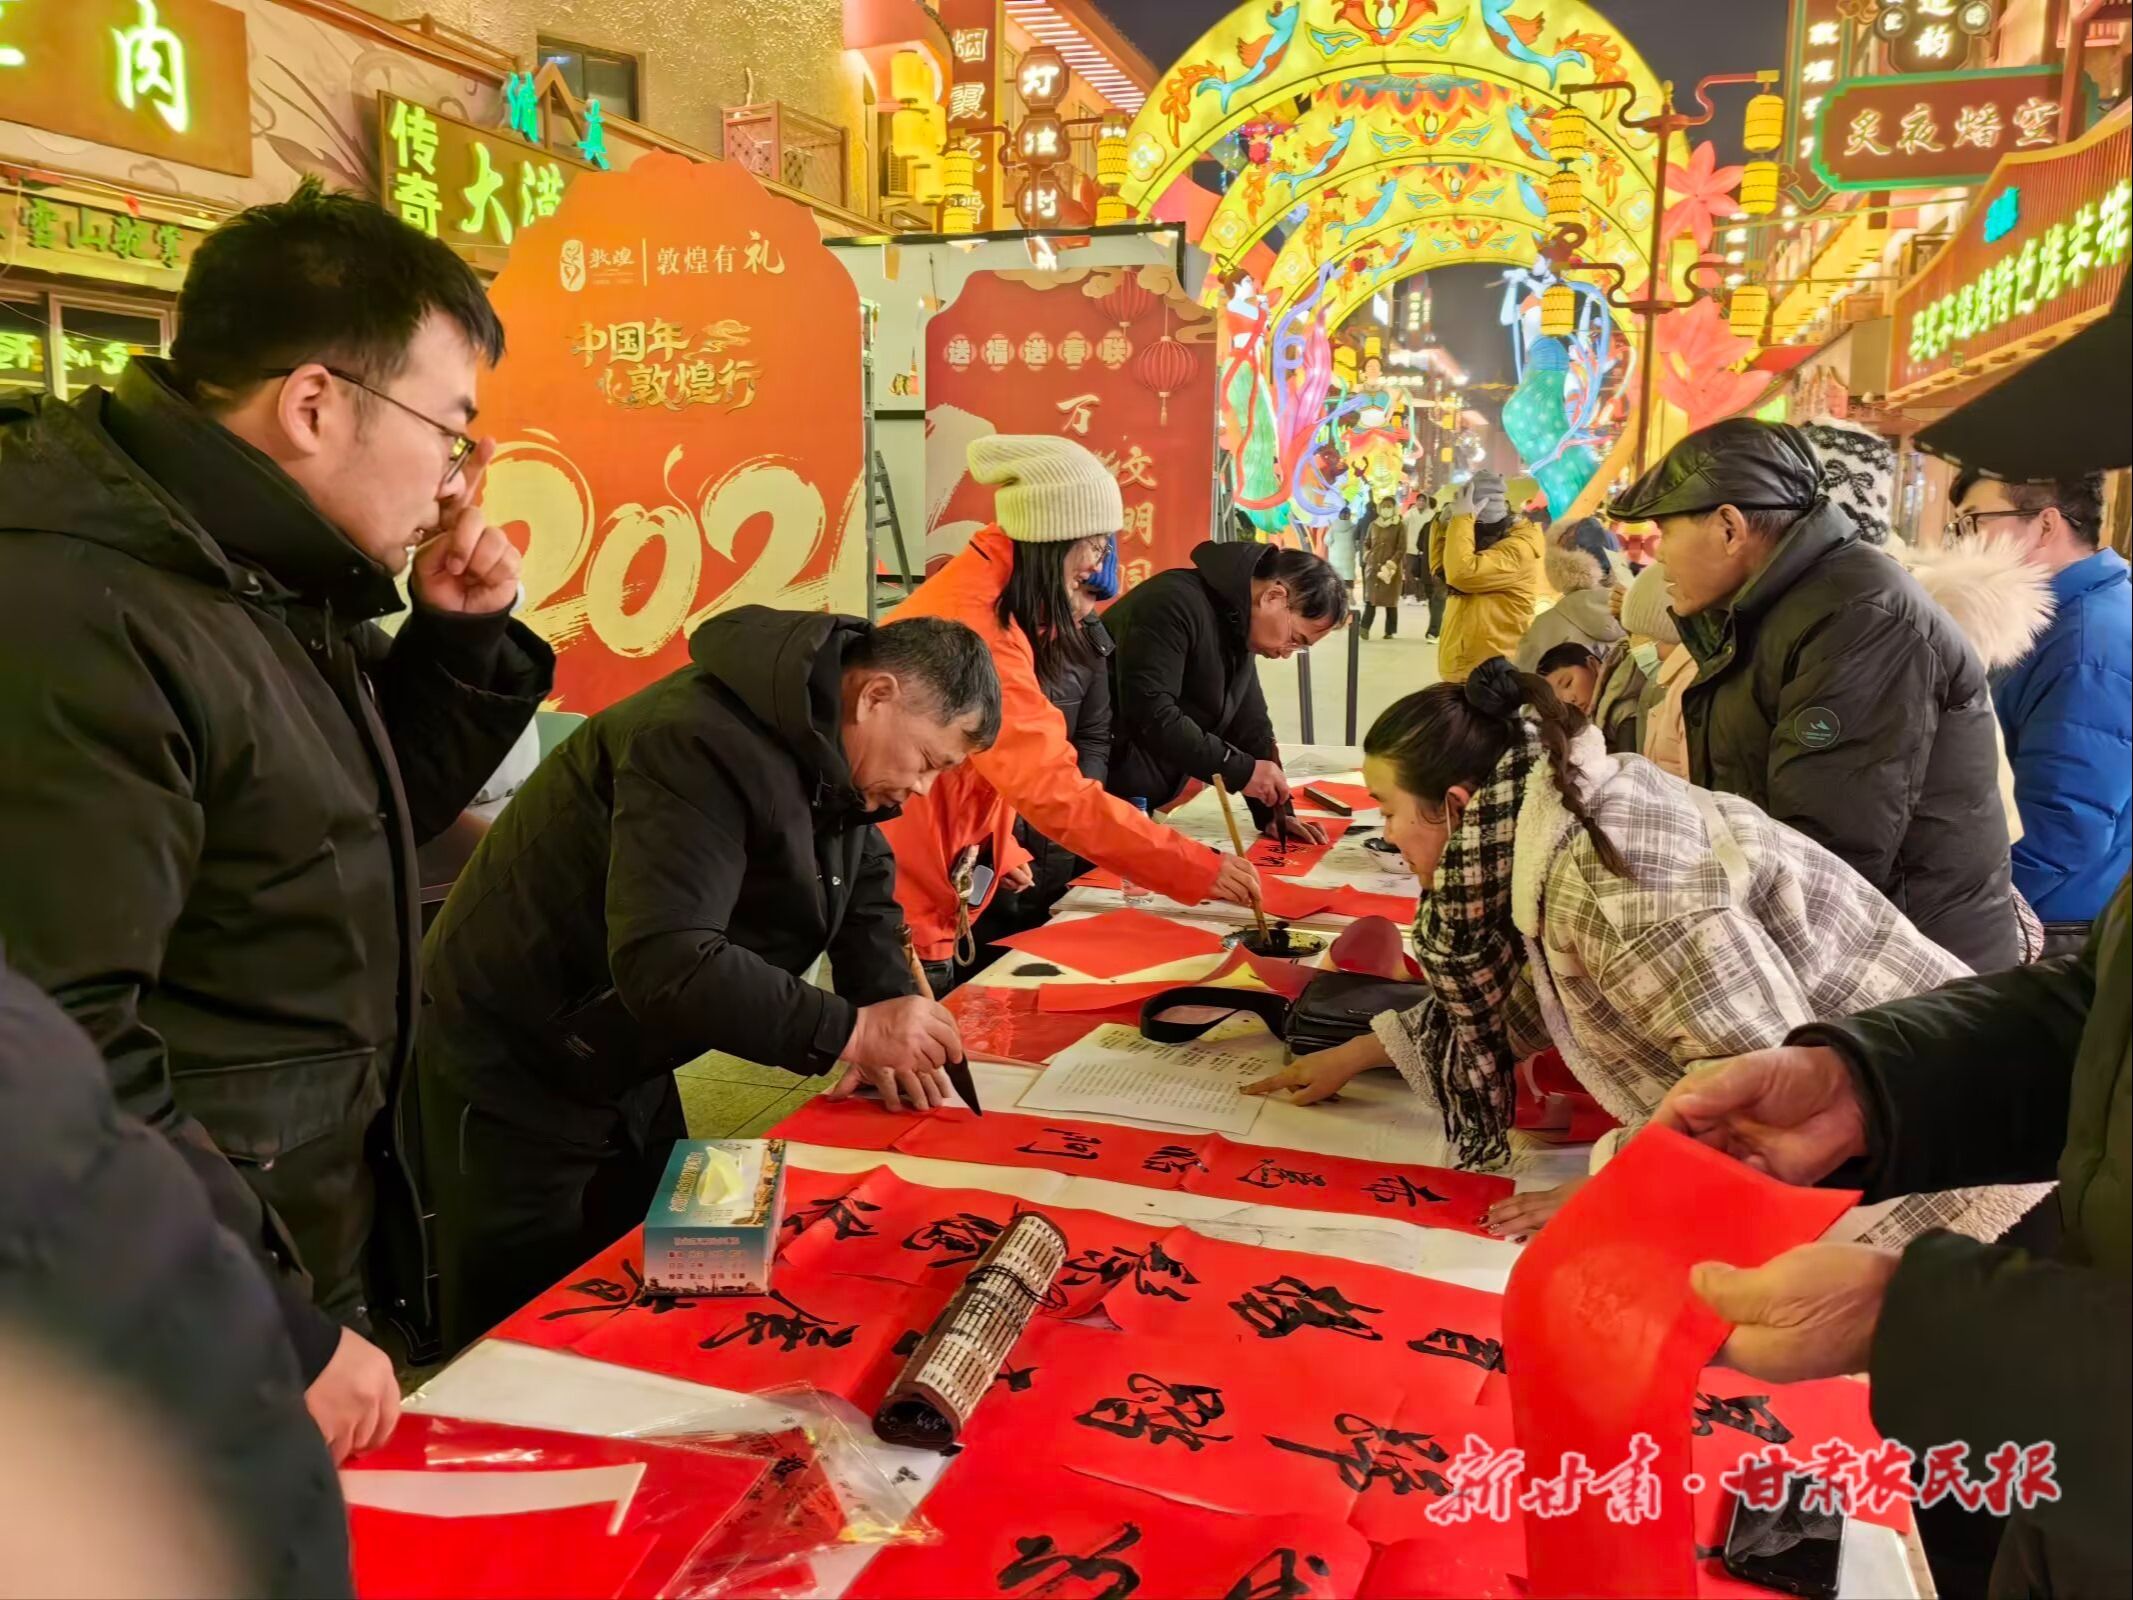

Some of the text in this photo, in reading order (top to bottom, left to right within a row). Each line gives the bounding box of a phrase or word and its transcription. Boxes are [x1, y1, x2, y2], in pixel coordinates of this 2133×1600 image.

[391, 100, 442, 238] 传奇
[589, 246, 635, 270] 敦煌
[657, 229, 786, 276] 敦煌有礼
[566, 316, 697, 370] 中国年
[622, 357, 765, 415] 敦煌行
